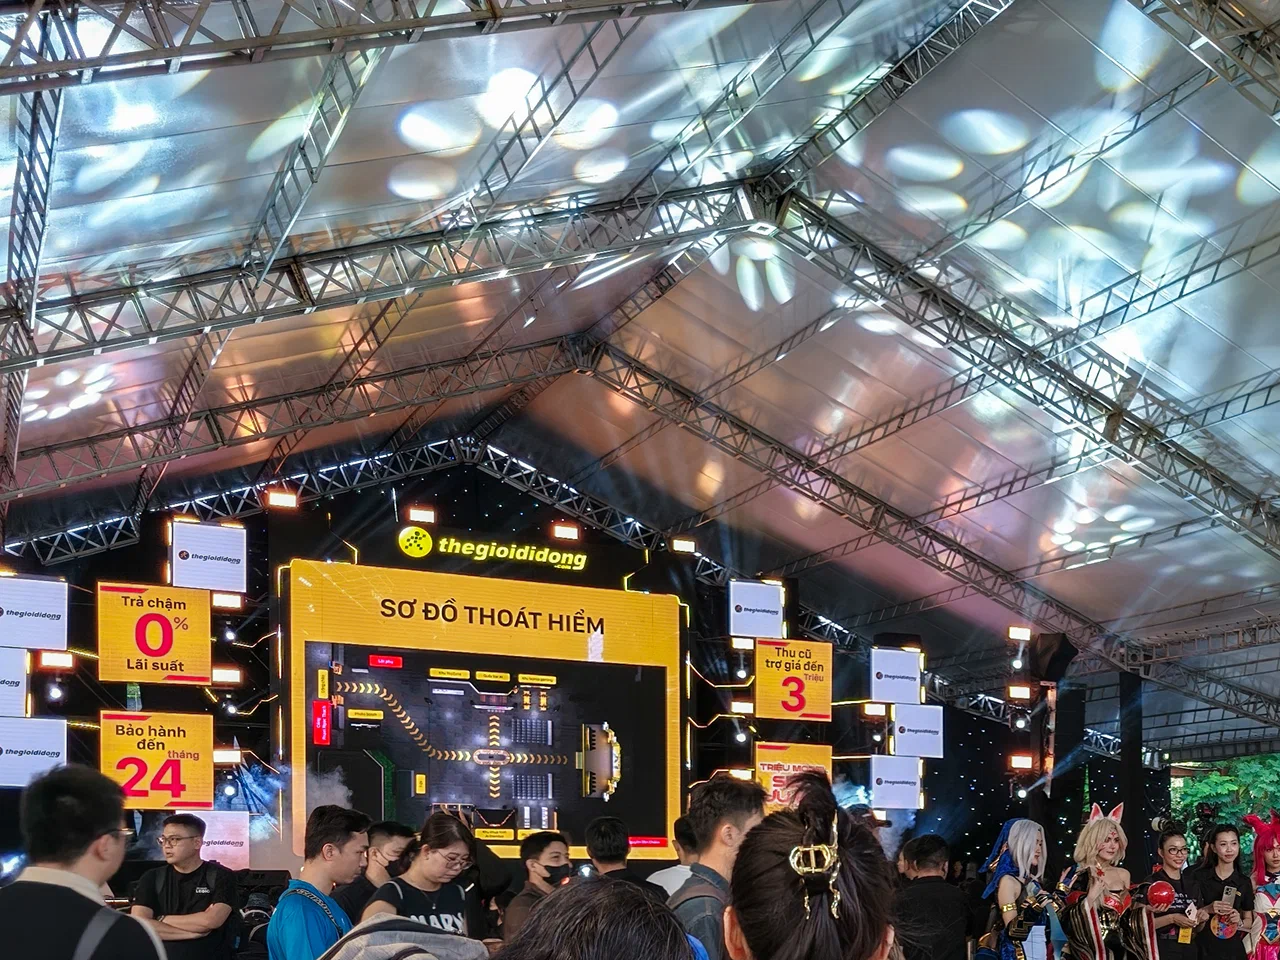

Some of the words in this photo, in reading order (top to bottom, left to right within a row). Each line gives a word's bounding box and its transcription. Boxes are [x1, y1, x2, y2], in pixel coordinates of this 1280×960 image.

[192, 553, 241, 564] thegioididong
[439, 537, 587, 570] thegioididong
[121, 596, 144, 608] Trả
[148, 597, 186, 610] chậm
[6, 610, 61, 620] thegioididong
[380, 598, 417, 619] SƠ
[422, 598, 458, 622] ĐỒ
[464, 607, 542, 629] THOÁT
[549, 609, 604, 634] HIỂM
[776, 647, 795, 658] Thu
[798, 649, 812, 659] cũ
[127, 659, 149, 670] Lãi
[152, 659, 184, 672] suất
[766, 660, 782, 672] trợ
[784, 660, 800, 672] giá
[804, 660, 824, 672] đến
[804, 674, 824, 683] Triệu
[782, 676, 806, 712] 3
[115, 725, 144, 736] Bảo
[148, 725, 186, 737] hành
[137, 739, 165, 750] đến
[5, 749, 60, 758] thegioididong
[168, 750, 199, 761] tháng
[760, 761, 790, 772] TRIỆU
[116, 757, 186, 797] 24
